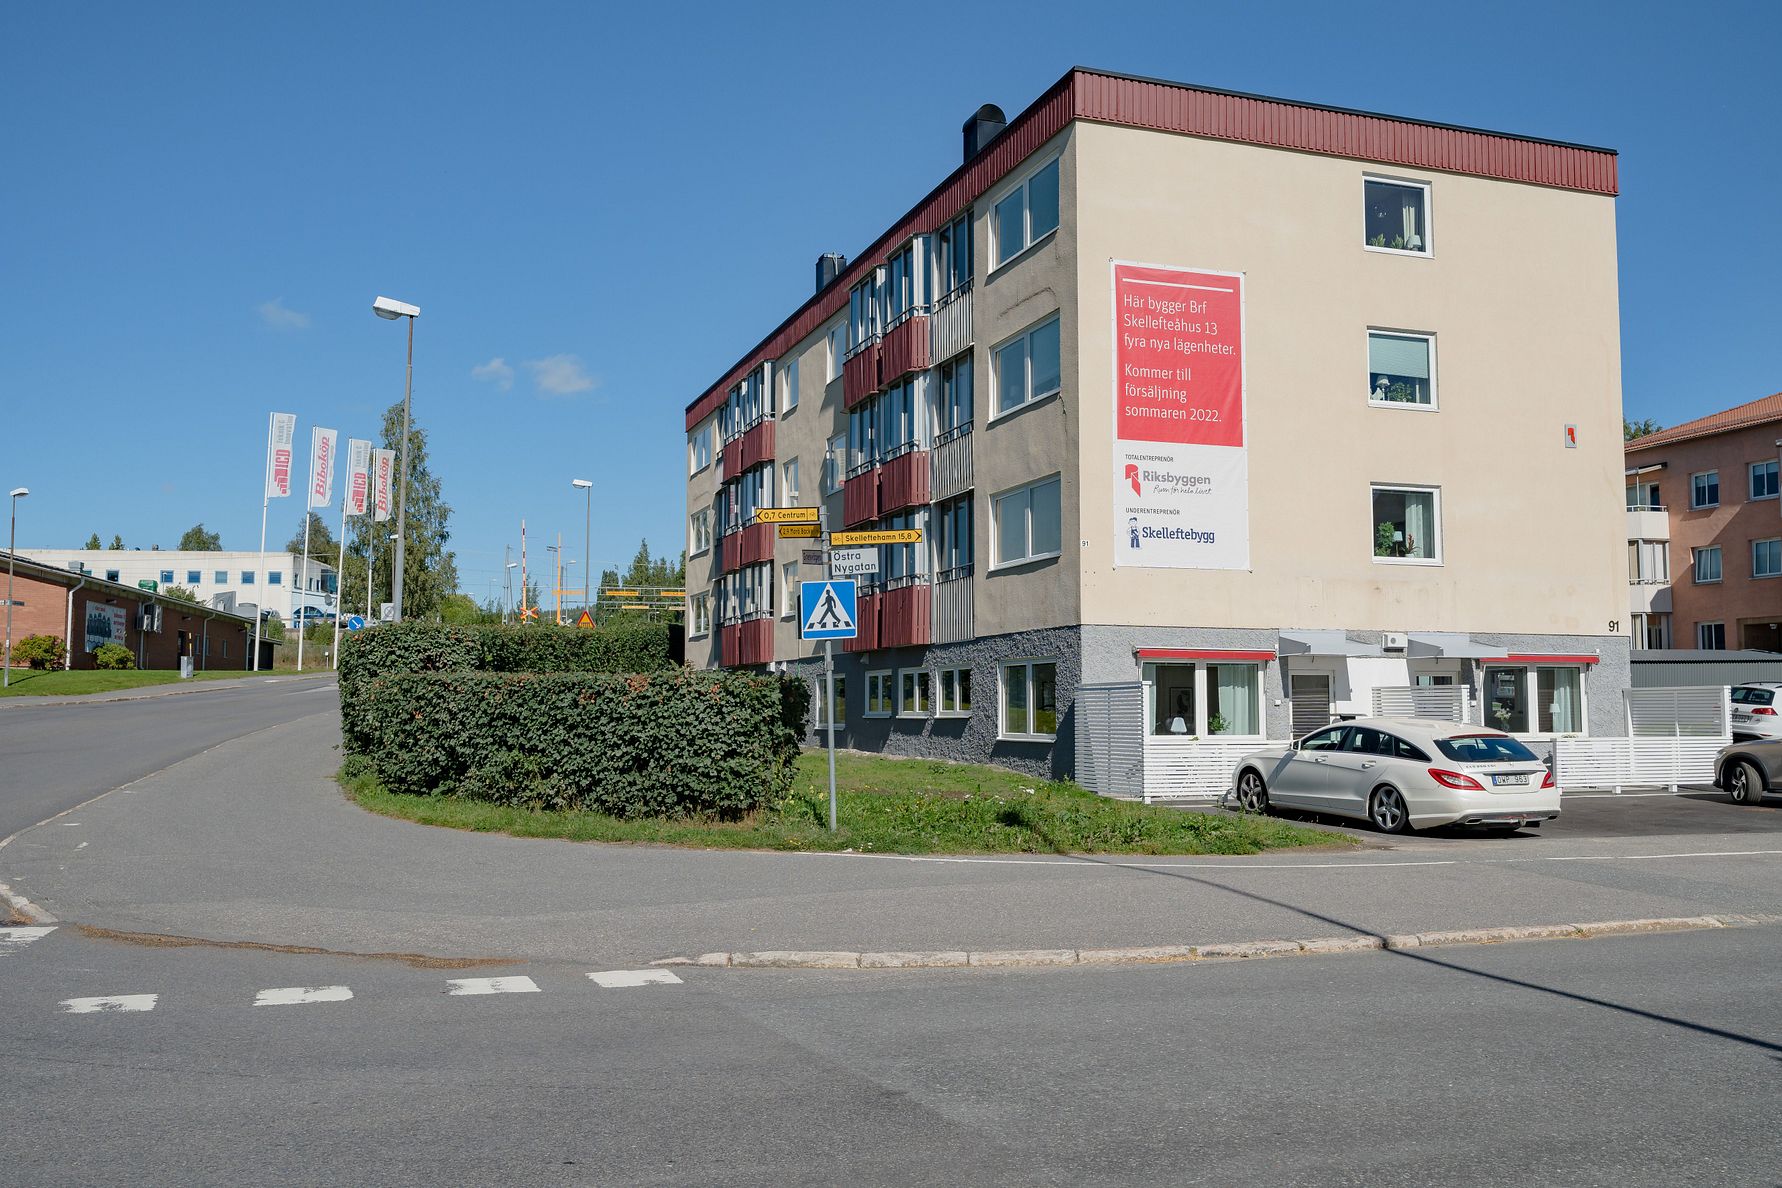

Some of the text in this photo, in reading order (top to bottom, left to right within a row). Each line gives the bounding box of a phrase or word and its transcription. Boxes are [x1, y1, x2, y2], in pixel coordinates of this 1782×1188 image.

[1124, 294, 1207, 314] Här bygger Brf
[1124, 314, 1218, 335] Skellefteåhus 13
[1124, 333, 1236, 355] fyra nya lägenheter.
[1125, 363, 1191, 381] Kommer till
[1125, 383, 1187, 403] försäljning
[1125, 406, 1222, 422] sommaren 2022.
[1125, 454, 1174, 462] TOTALENTREPRENÖR
[315, 436, 330, 497] Biboköp
[378, 457, 389, 512] Biboköp
[1143, 470, 1211, 486] Riksbyggen
[764, 511, 806, 520] 0,7 Centrum
[1126, 507, 1180, 515] UNDERENTREPRENÖR
[846, 533, 912, 542] Skelleftehamn 15,8
[1142, 526, 1215, 544] Skelleftebygg
[834, 550, 861, 560] Östra
[834, 563, 876, 574] Nygatan
[1608, 620, 1620, 632] 91
